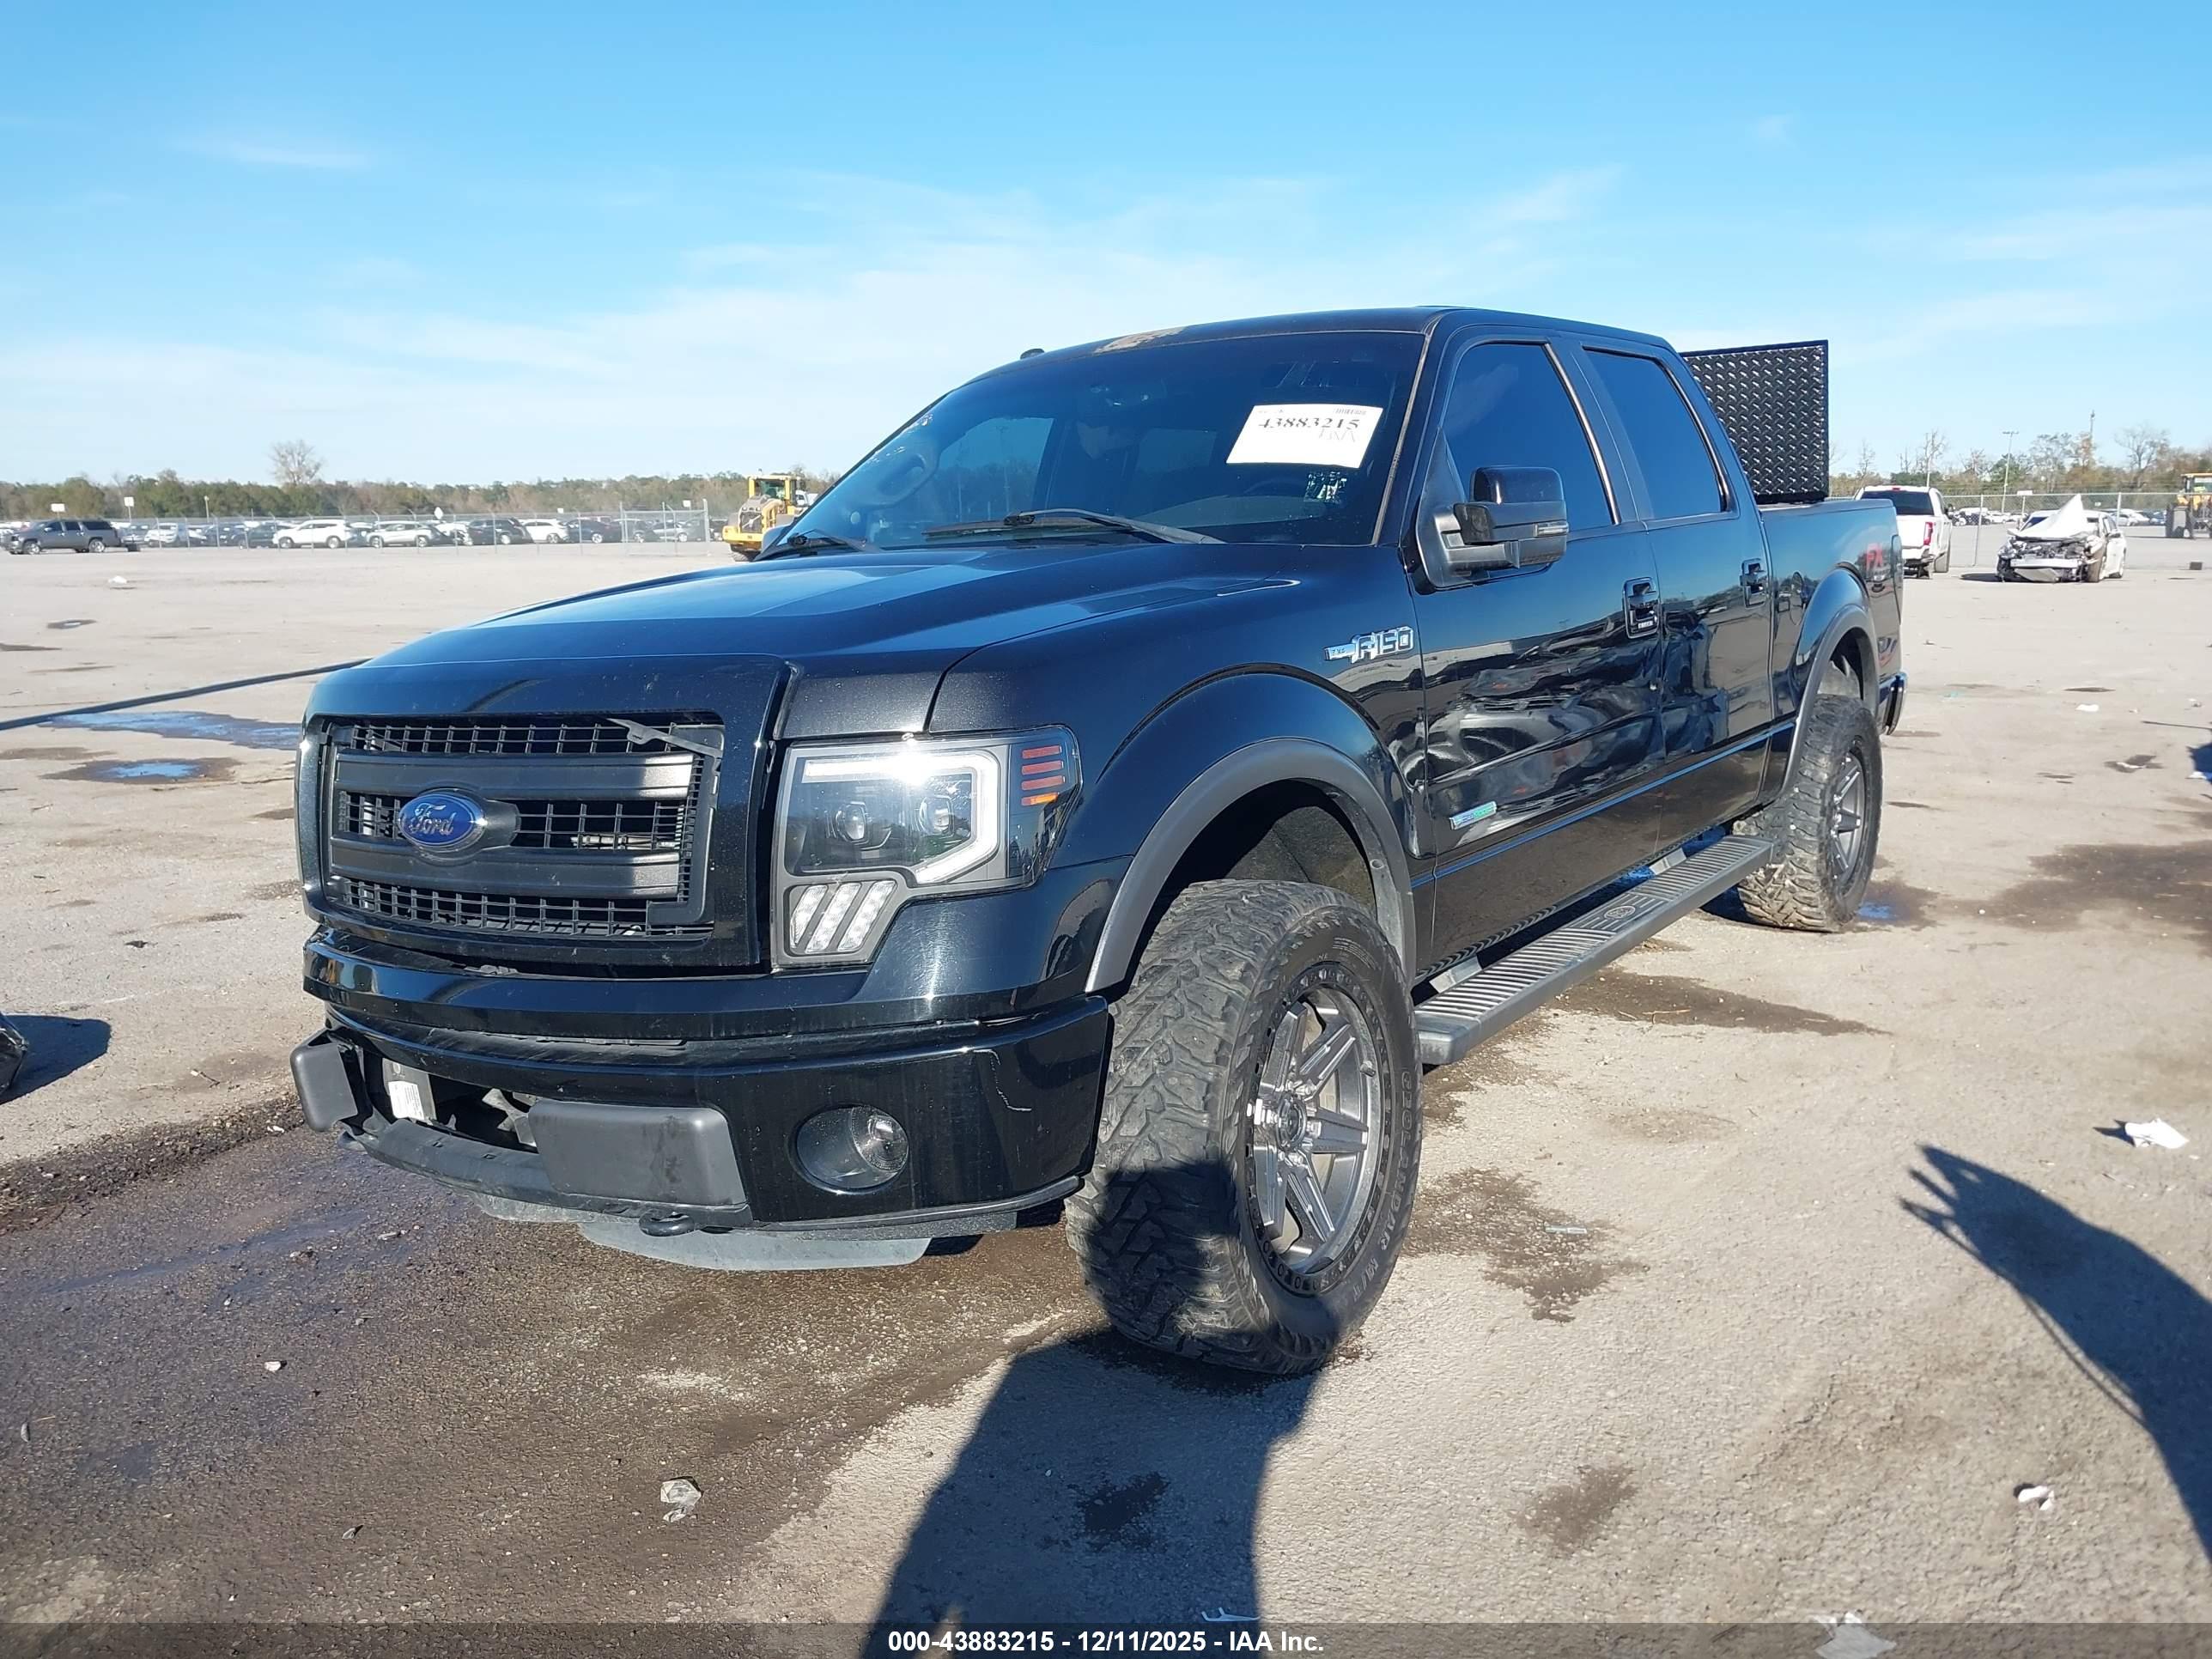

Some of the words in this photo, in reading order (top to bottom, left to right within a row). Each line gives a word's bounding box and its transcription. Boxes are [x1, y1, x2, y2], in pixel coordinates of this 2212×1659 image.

[1258, 416, 1360, 430] 43883215
[408, 802, 458, 836] Ford
[1378, 1071, 1413, 1251] GEOLANDAR
